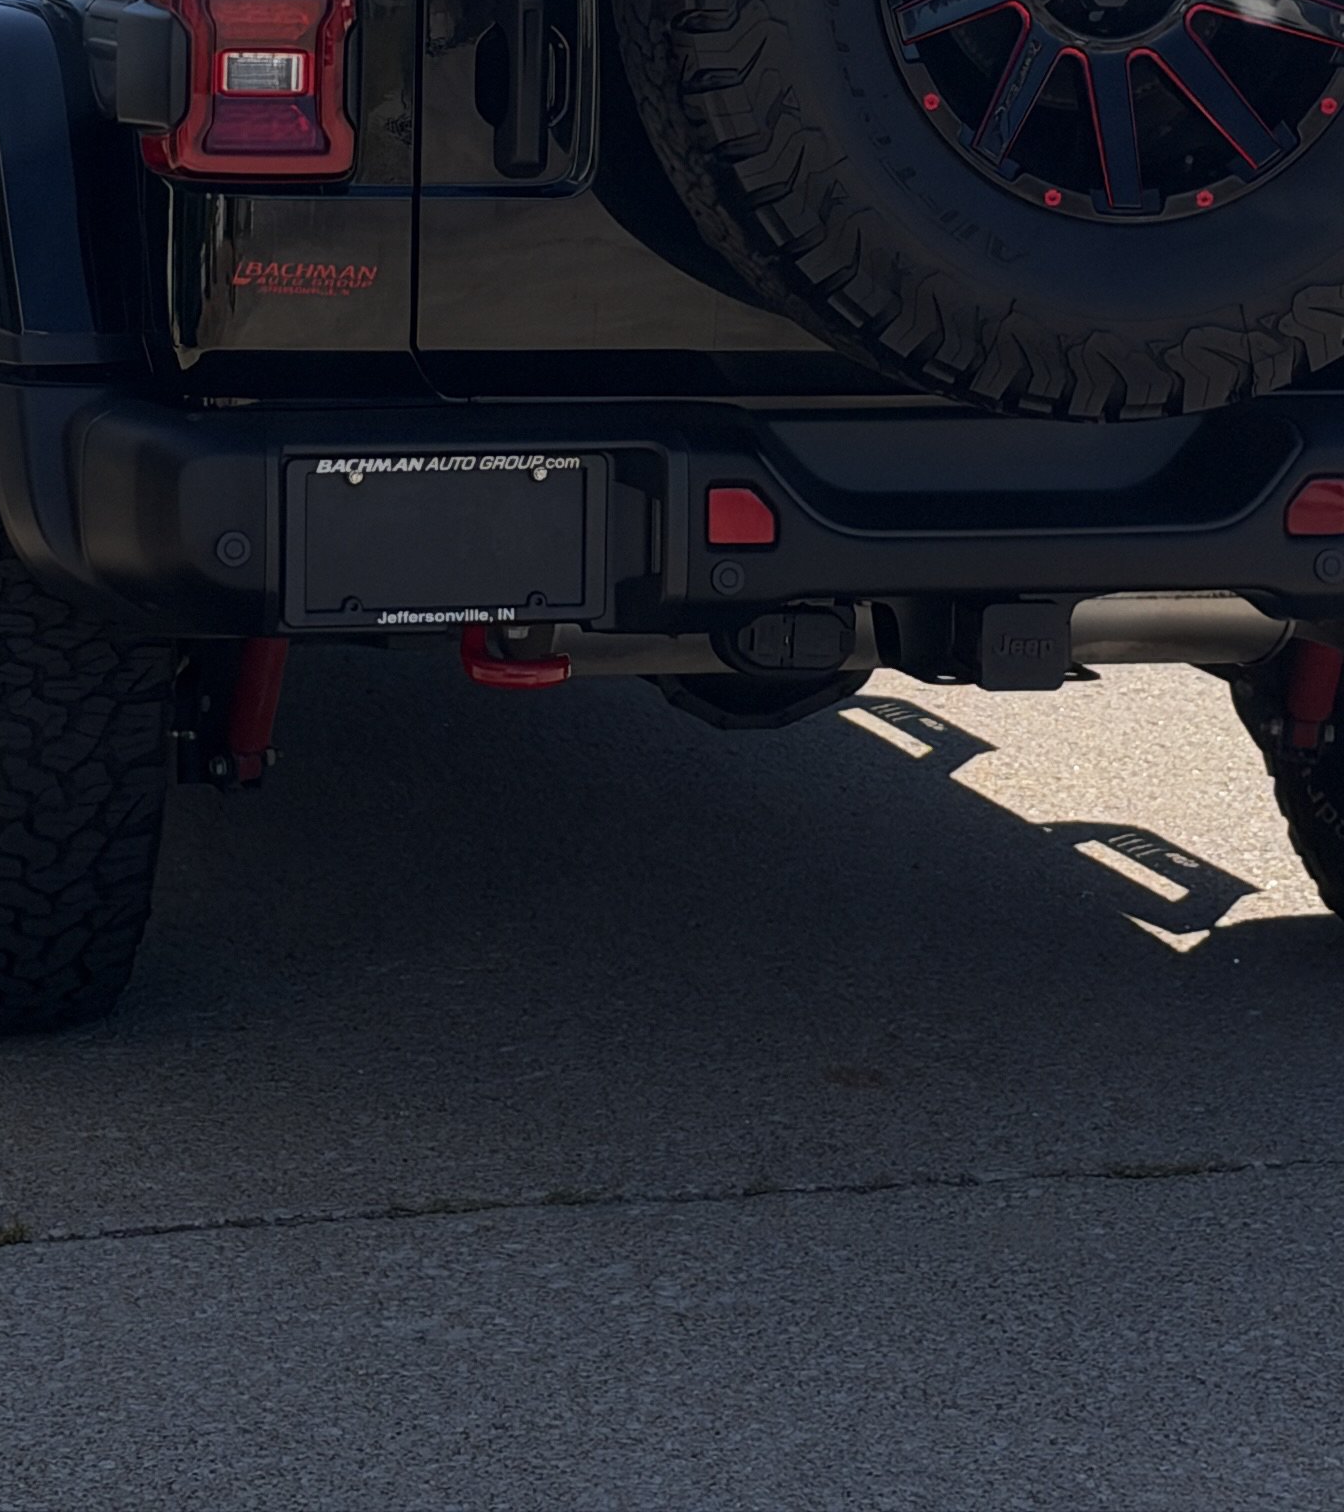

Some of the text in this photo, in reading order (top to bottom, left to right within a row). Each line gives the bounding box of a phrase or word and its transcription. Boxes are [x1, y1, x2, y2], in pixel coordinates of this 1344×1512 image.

[244, 262, 378, 280] BACHMAN
[315, 454, 581, 474] BACHMAN AUTO GROUPcom
[376, 607, 516, 625] Jeffersonville, IN
